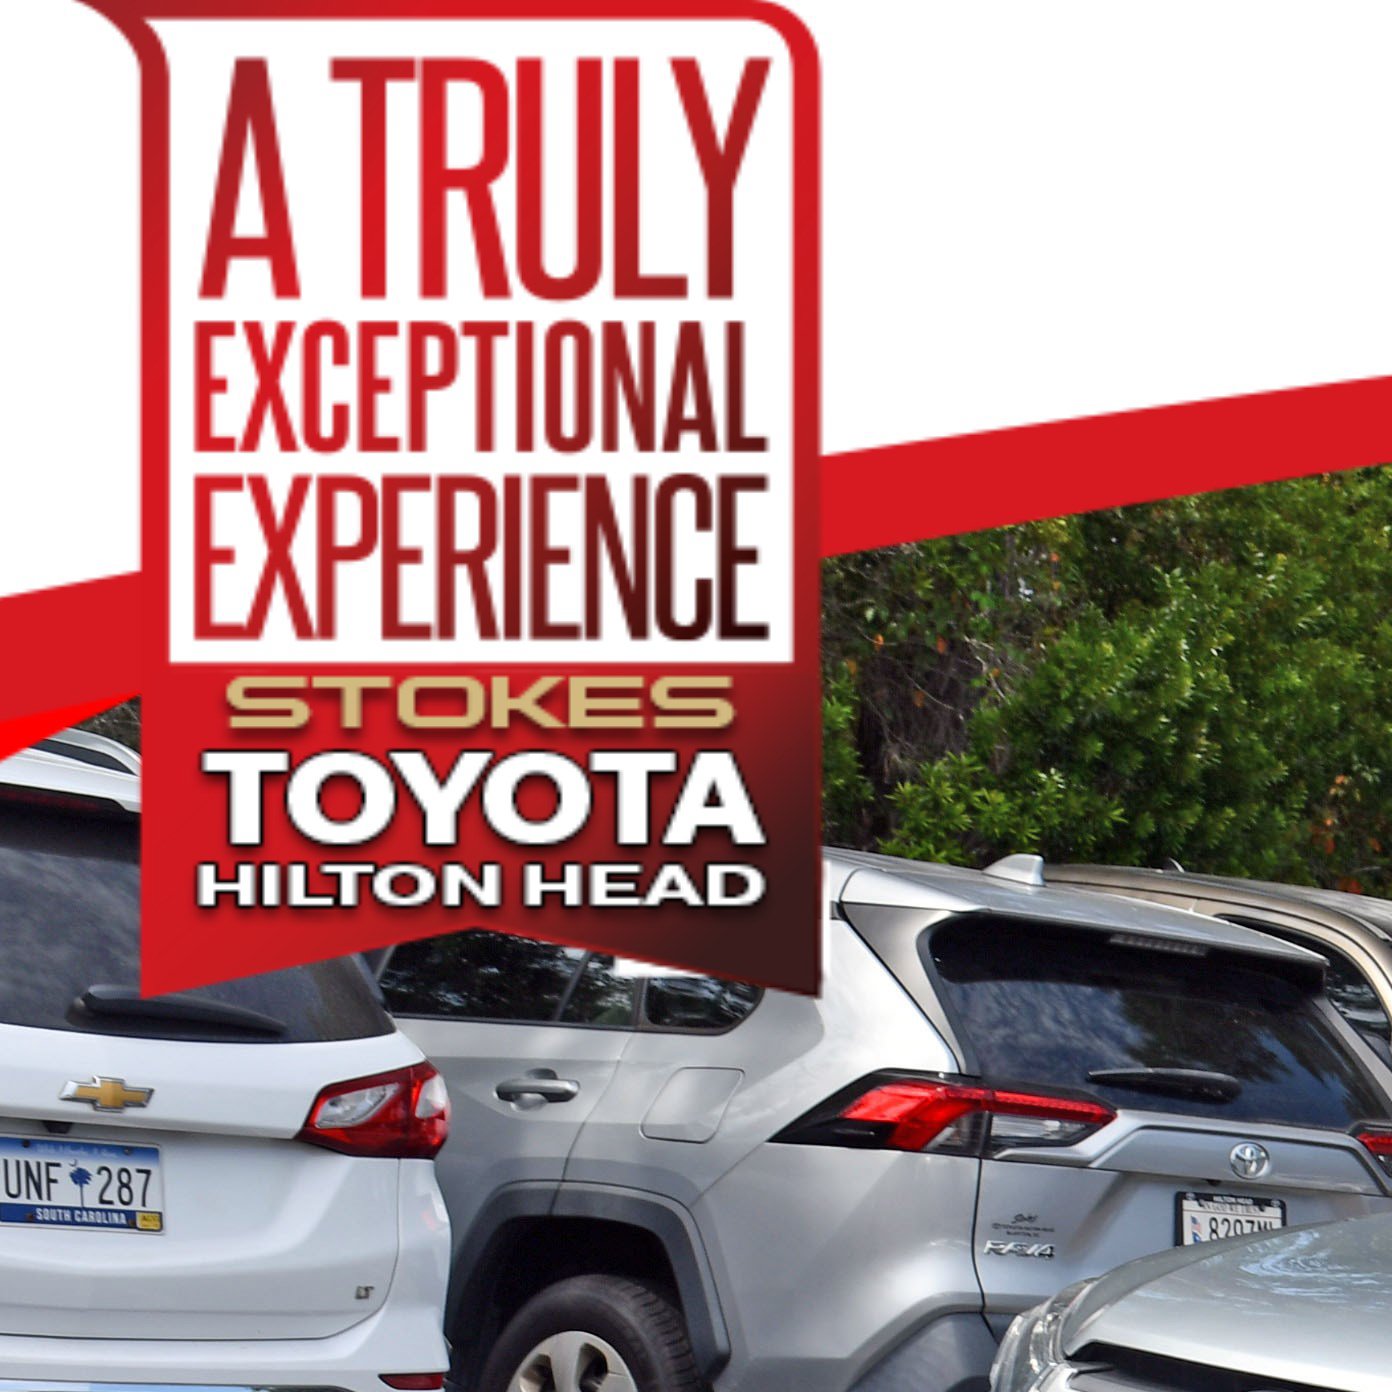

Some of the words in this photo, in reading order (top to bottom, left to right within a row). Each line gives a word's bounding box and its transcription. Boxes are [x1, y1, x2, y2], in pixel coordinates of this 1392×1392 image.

[3, 1158, 62, 1202] UNF
[97, 1165, 153, 1208] 287
[35, 1207, 72, 1222] SOUTH
[74, 1210, 127, 1226] CAROLINA
